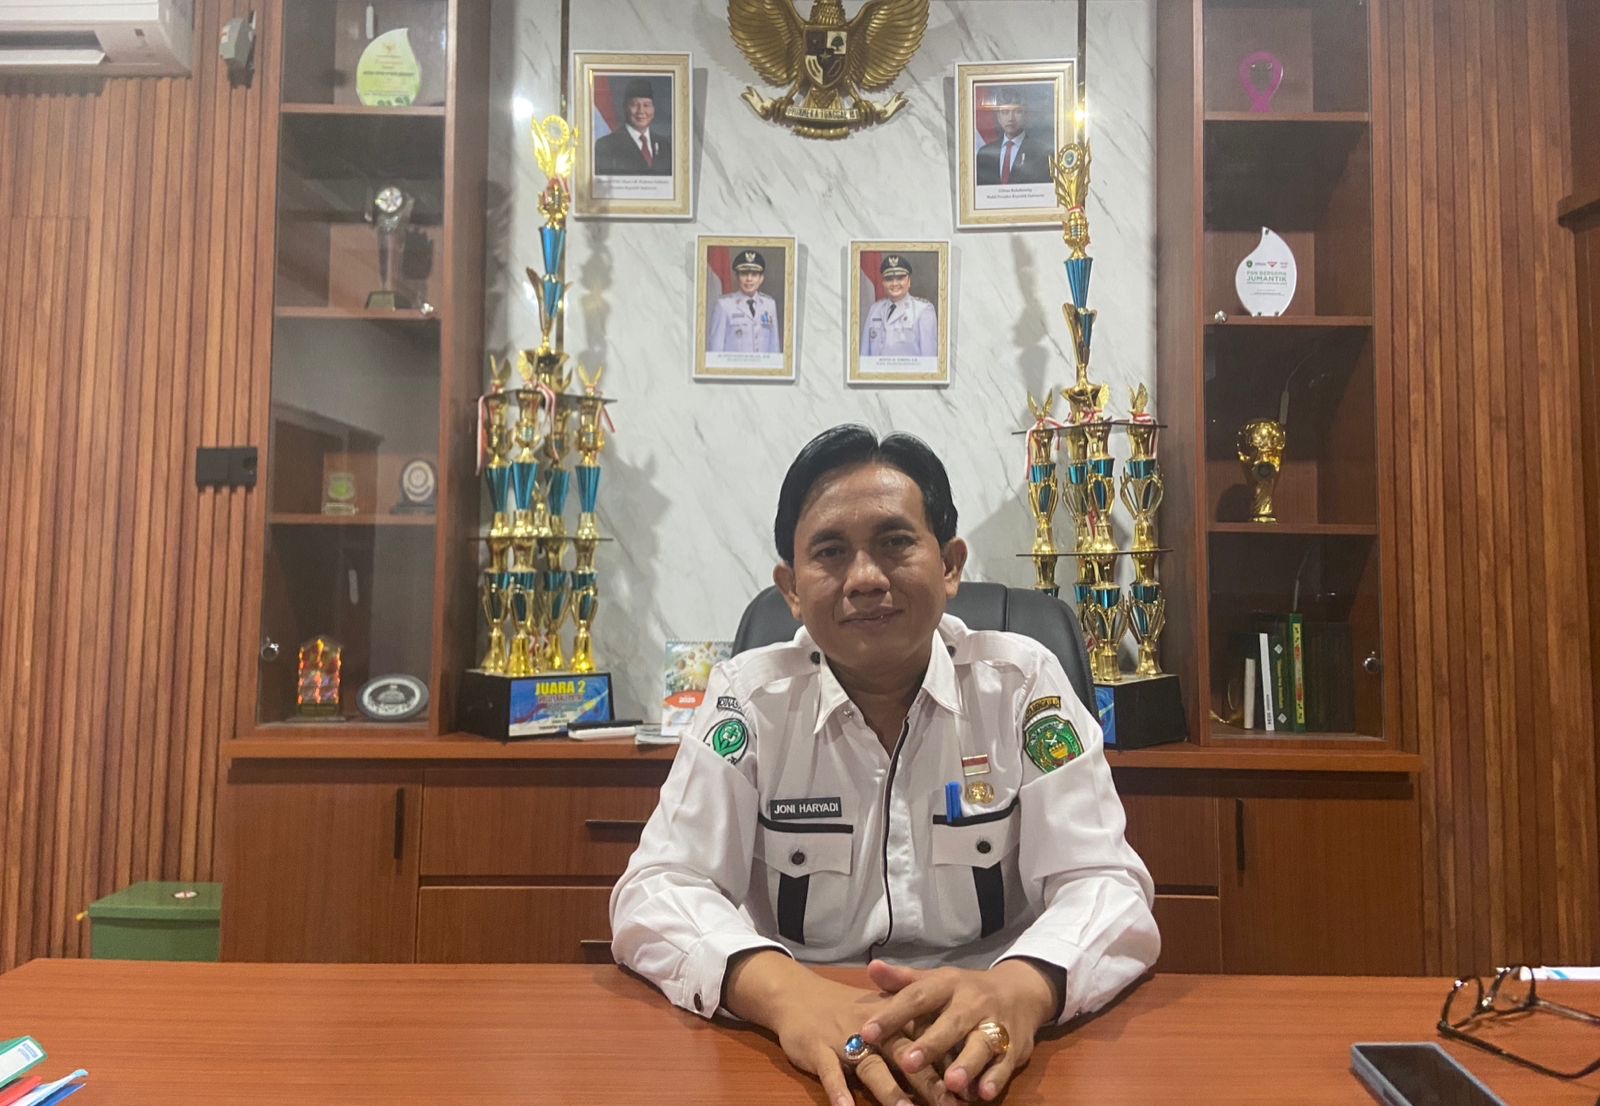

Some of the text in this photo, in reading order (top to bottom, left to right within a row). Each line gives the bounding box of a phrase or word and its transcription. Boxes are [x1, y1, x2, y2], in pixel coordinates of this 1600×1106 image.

[535, 680, 586, 696] JUARA 2
[774, 802, 839, 814] JONI HARYADI
